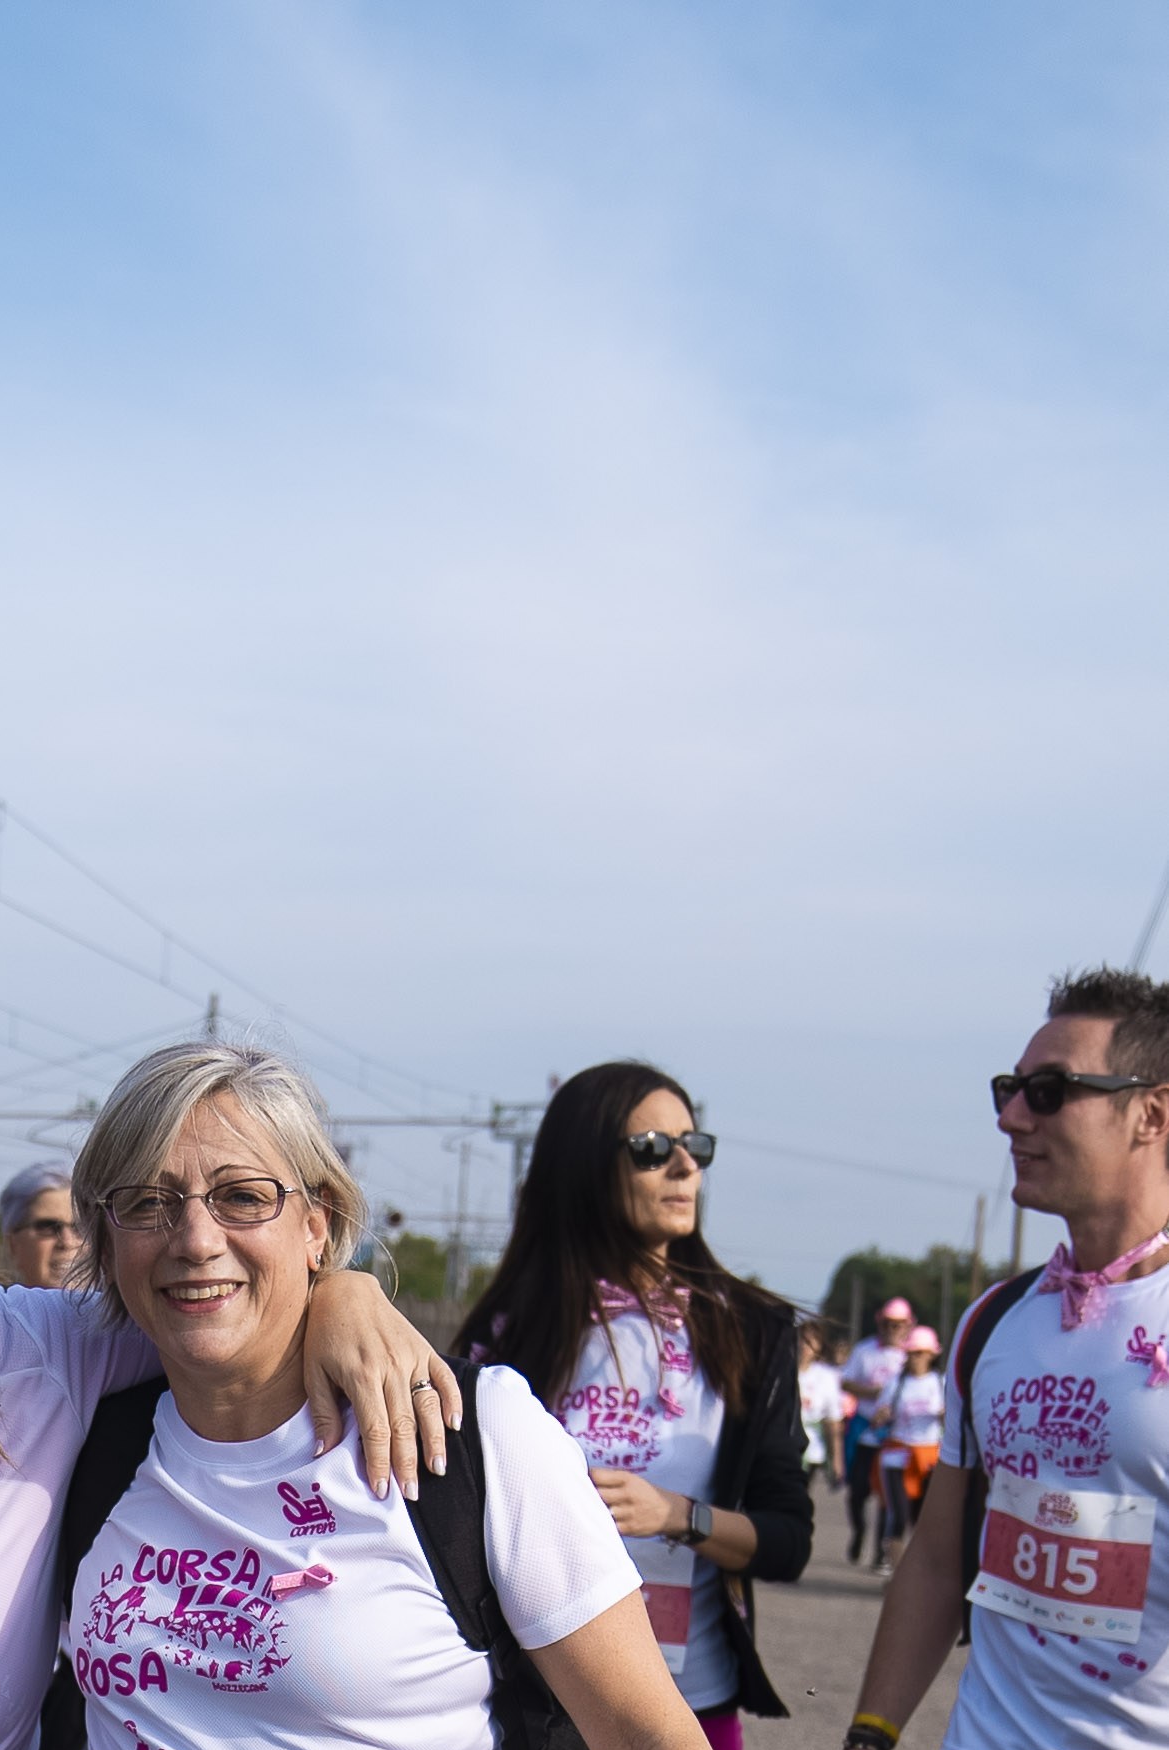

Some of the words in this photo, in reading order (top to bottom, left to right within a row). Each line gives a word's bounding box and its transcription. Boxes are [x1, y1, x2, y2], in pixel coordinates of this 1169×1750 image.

[558, 1385, 640, 1411] CORSA
[1010, 1374, 1097, 1406] CORSA
[290, 1521, 336, 1538] correre
[101, 1563, 124, 1588] LA
[132, 1543, 261, 1590] CORSA
[1013, 1533, 1099, 1595] 815
[76, 1648, 168, 1696] ROSA
